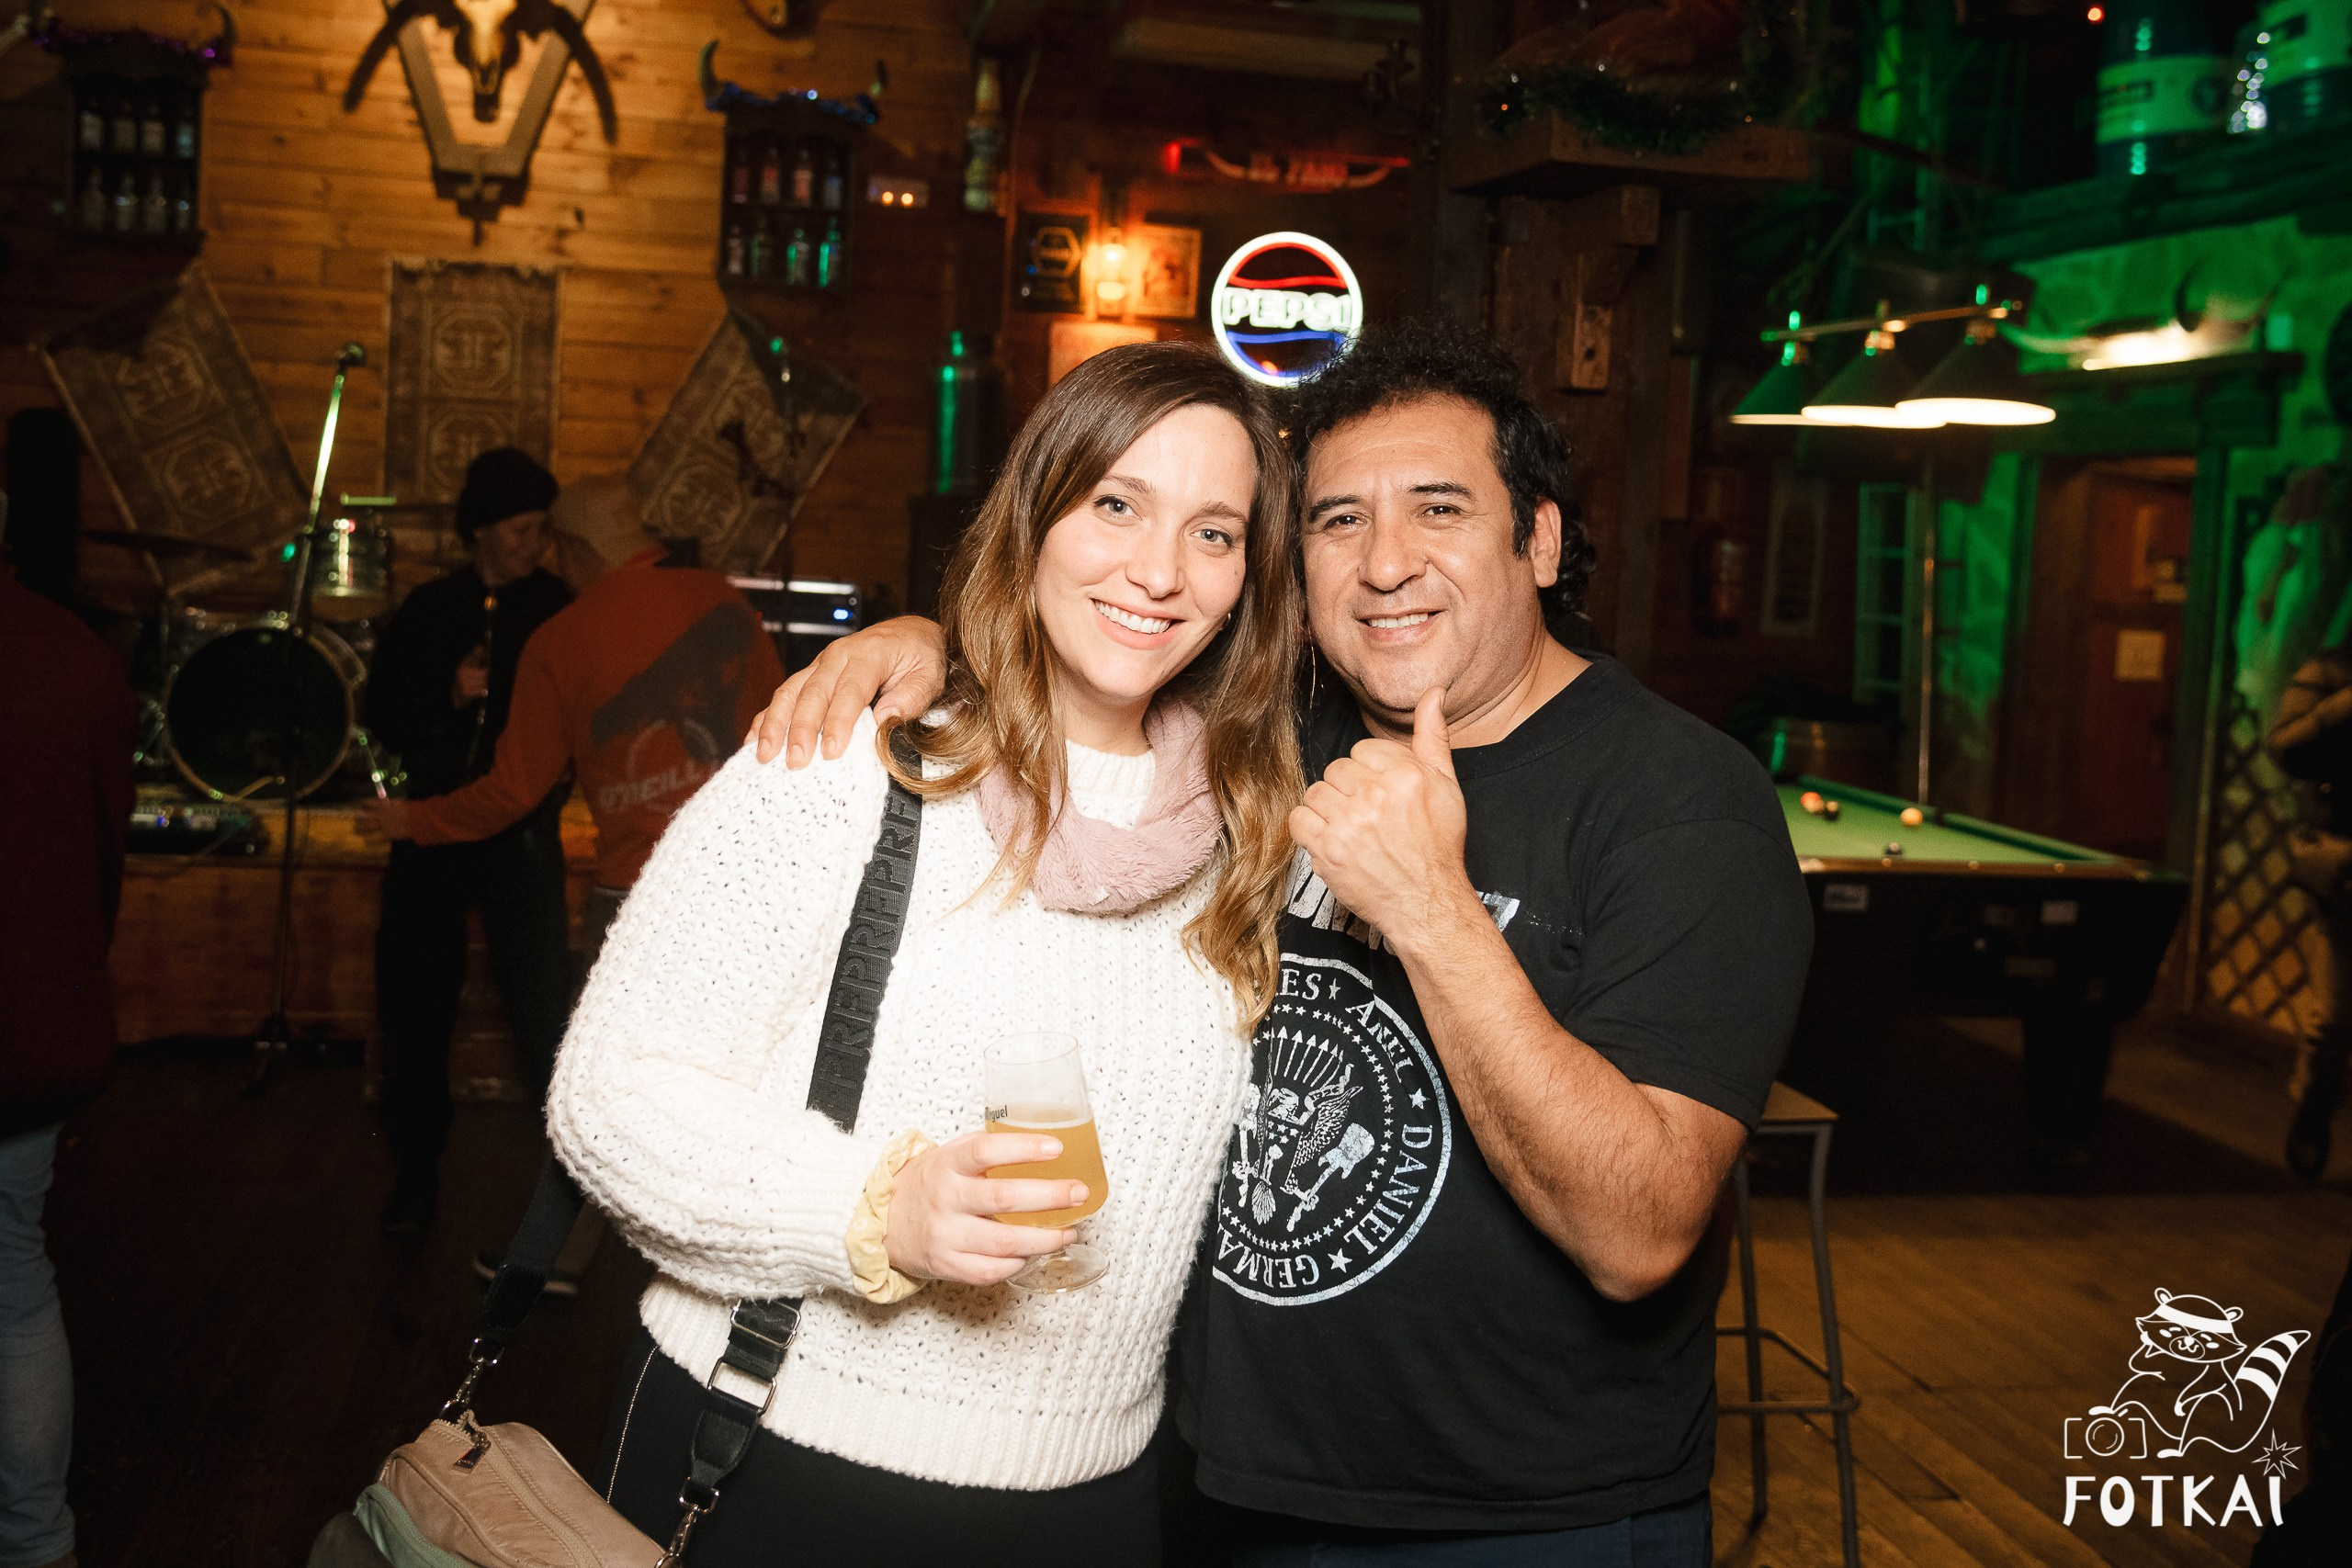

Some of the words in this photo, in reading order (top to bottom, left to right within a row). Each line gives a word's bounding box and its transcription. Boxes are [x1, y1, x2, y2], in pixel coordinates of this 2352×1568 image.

[1222, 288, 1352, 332] PEPSI
[1275, 967, 1322, 1001] ES
[1342, 1123, 1434, 1255] DANIEL
[1216, 1223, 1321, 1289] GERMA
